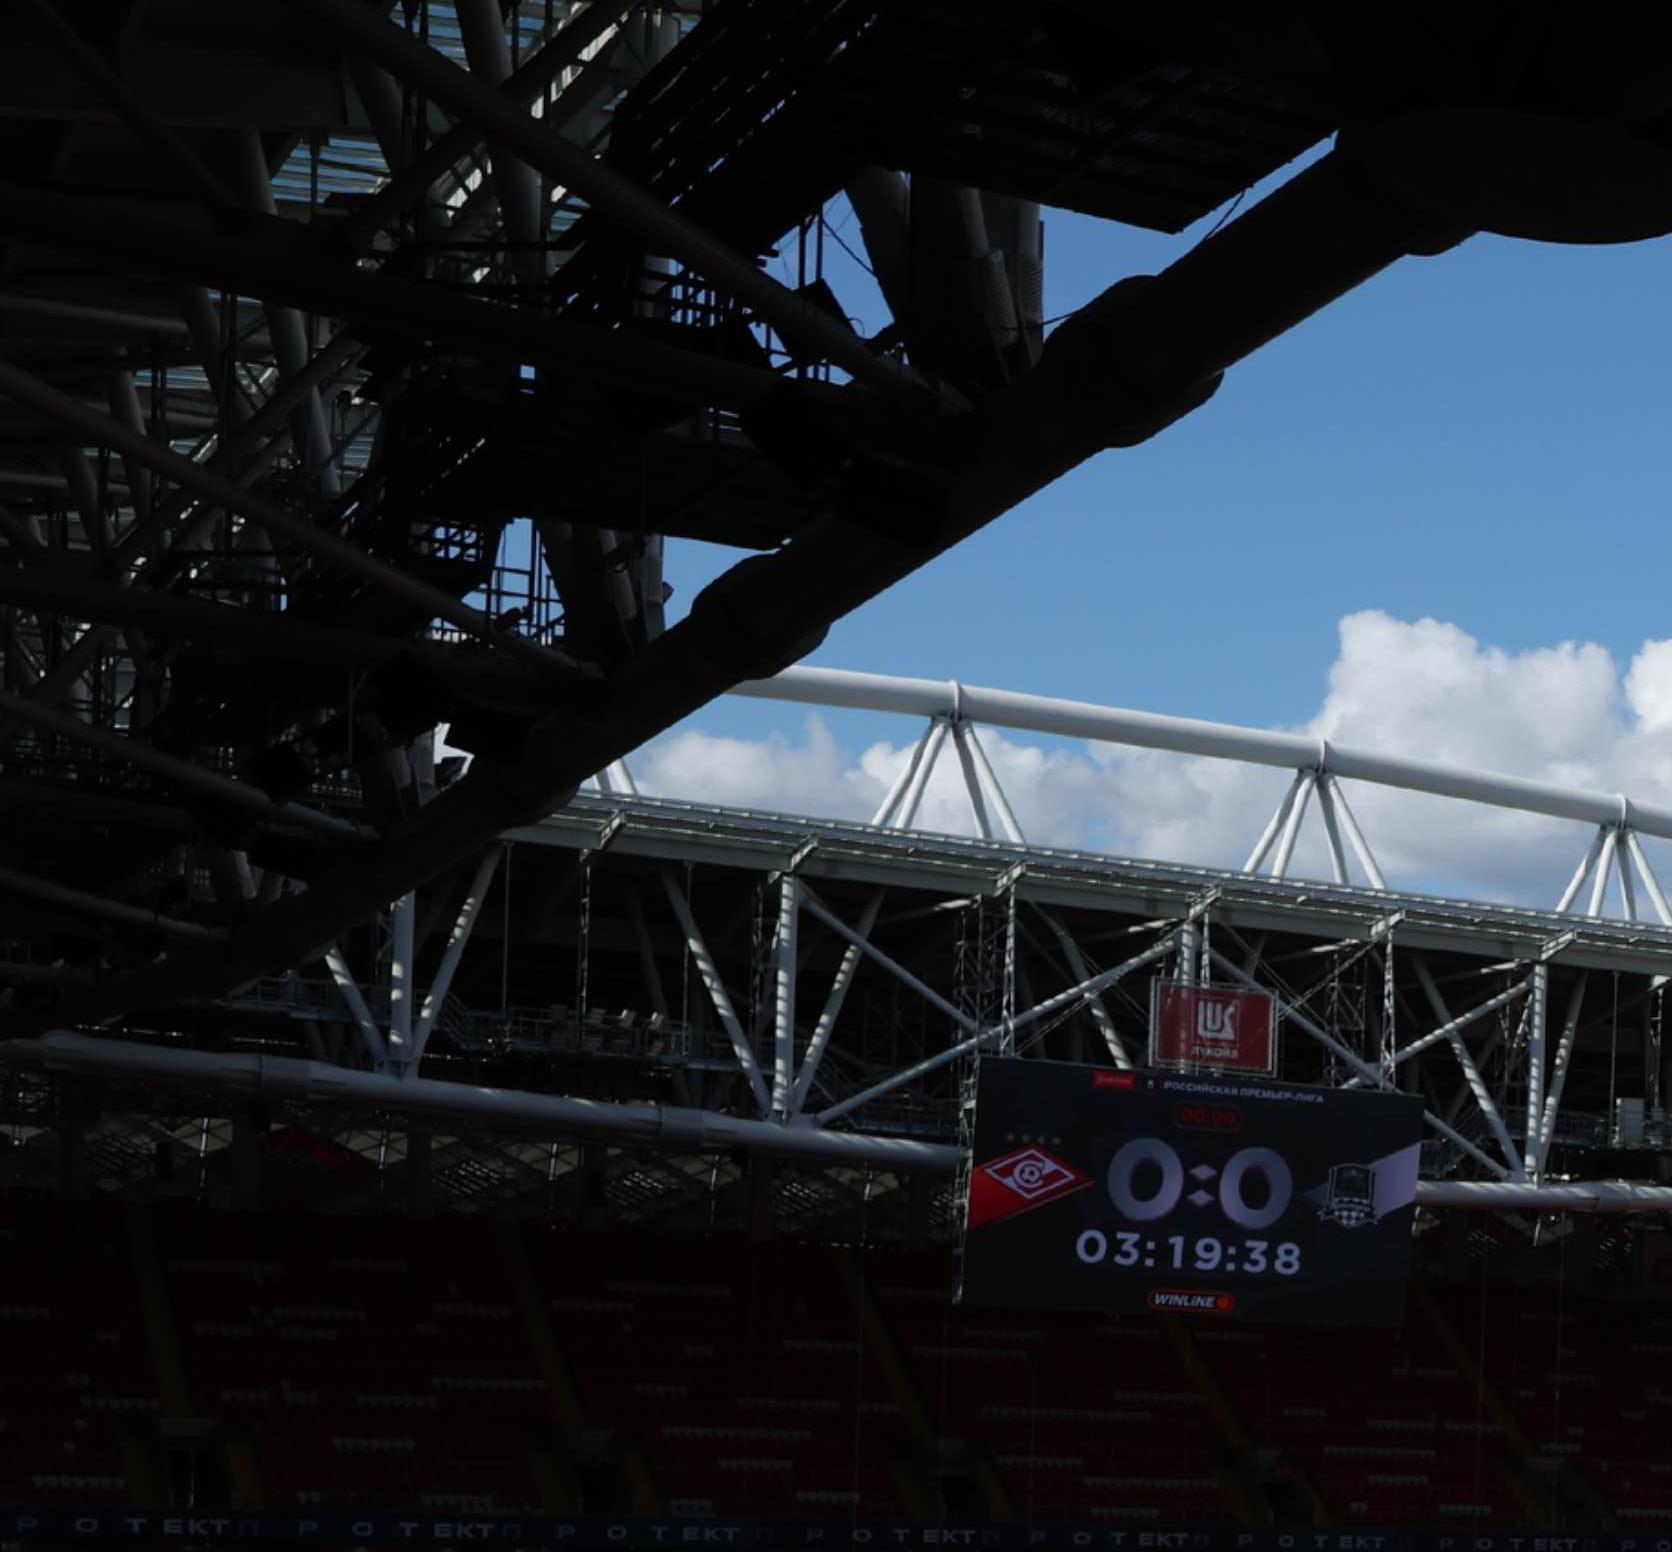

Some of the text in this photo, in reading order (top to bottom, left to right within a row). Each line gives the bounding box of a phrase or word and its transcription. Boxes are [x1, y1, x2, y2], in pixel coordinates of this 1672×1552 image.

[1162, 1080, 1325, 1104] РОССИЙСКАЯ ПРЕМЬЕР-ЛИГА
[1075, 1228, 1301, 1276] 03:19:38
[1153, 1292, 1217, 1310] WINLINE
